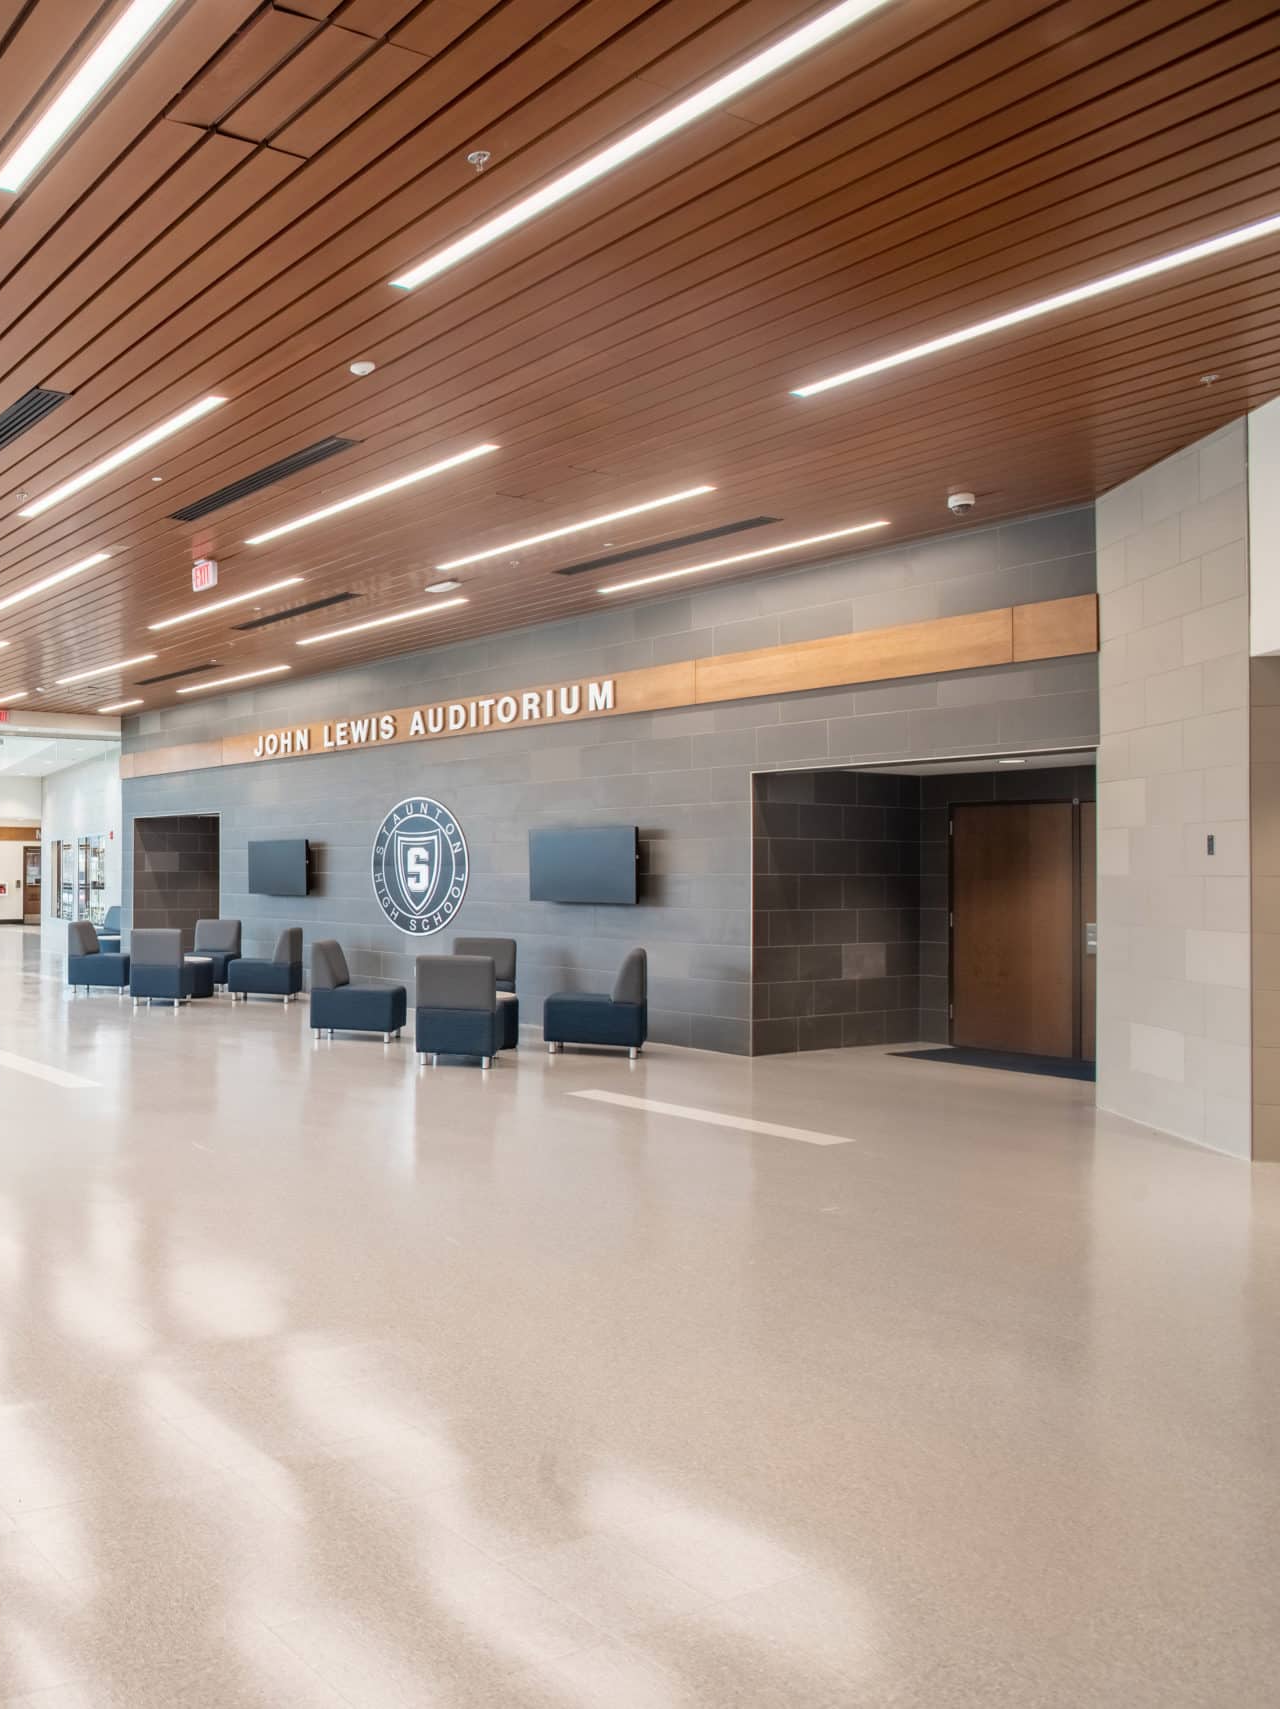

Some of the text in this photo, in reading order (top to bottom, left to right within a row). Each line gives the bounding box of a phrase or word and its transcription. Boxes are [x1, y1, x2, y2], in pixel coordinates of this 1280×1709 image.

[195, 564, 209, 588] EXIT
[254, 680, 615, 757] JOHN LEWIS AUDITORIUM
[376, 803, 463, 855] STAUNTON
[407, 846, 429, 892] S
[375, 872, 465, 931] HIGH SCHOOL
